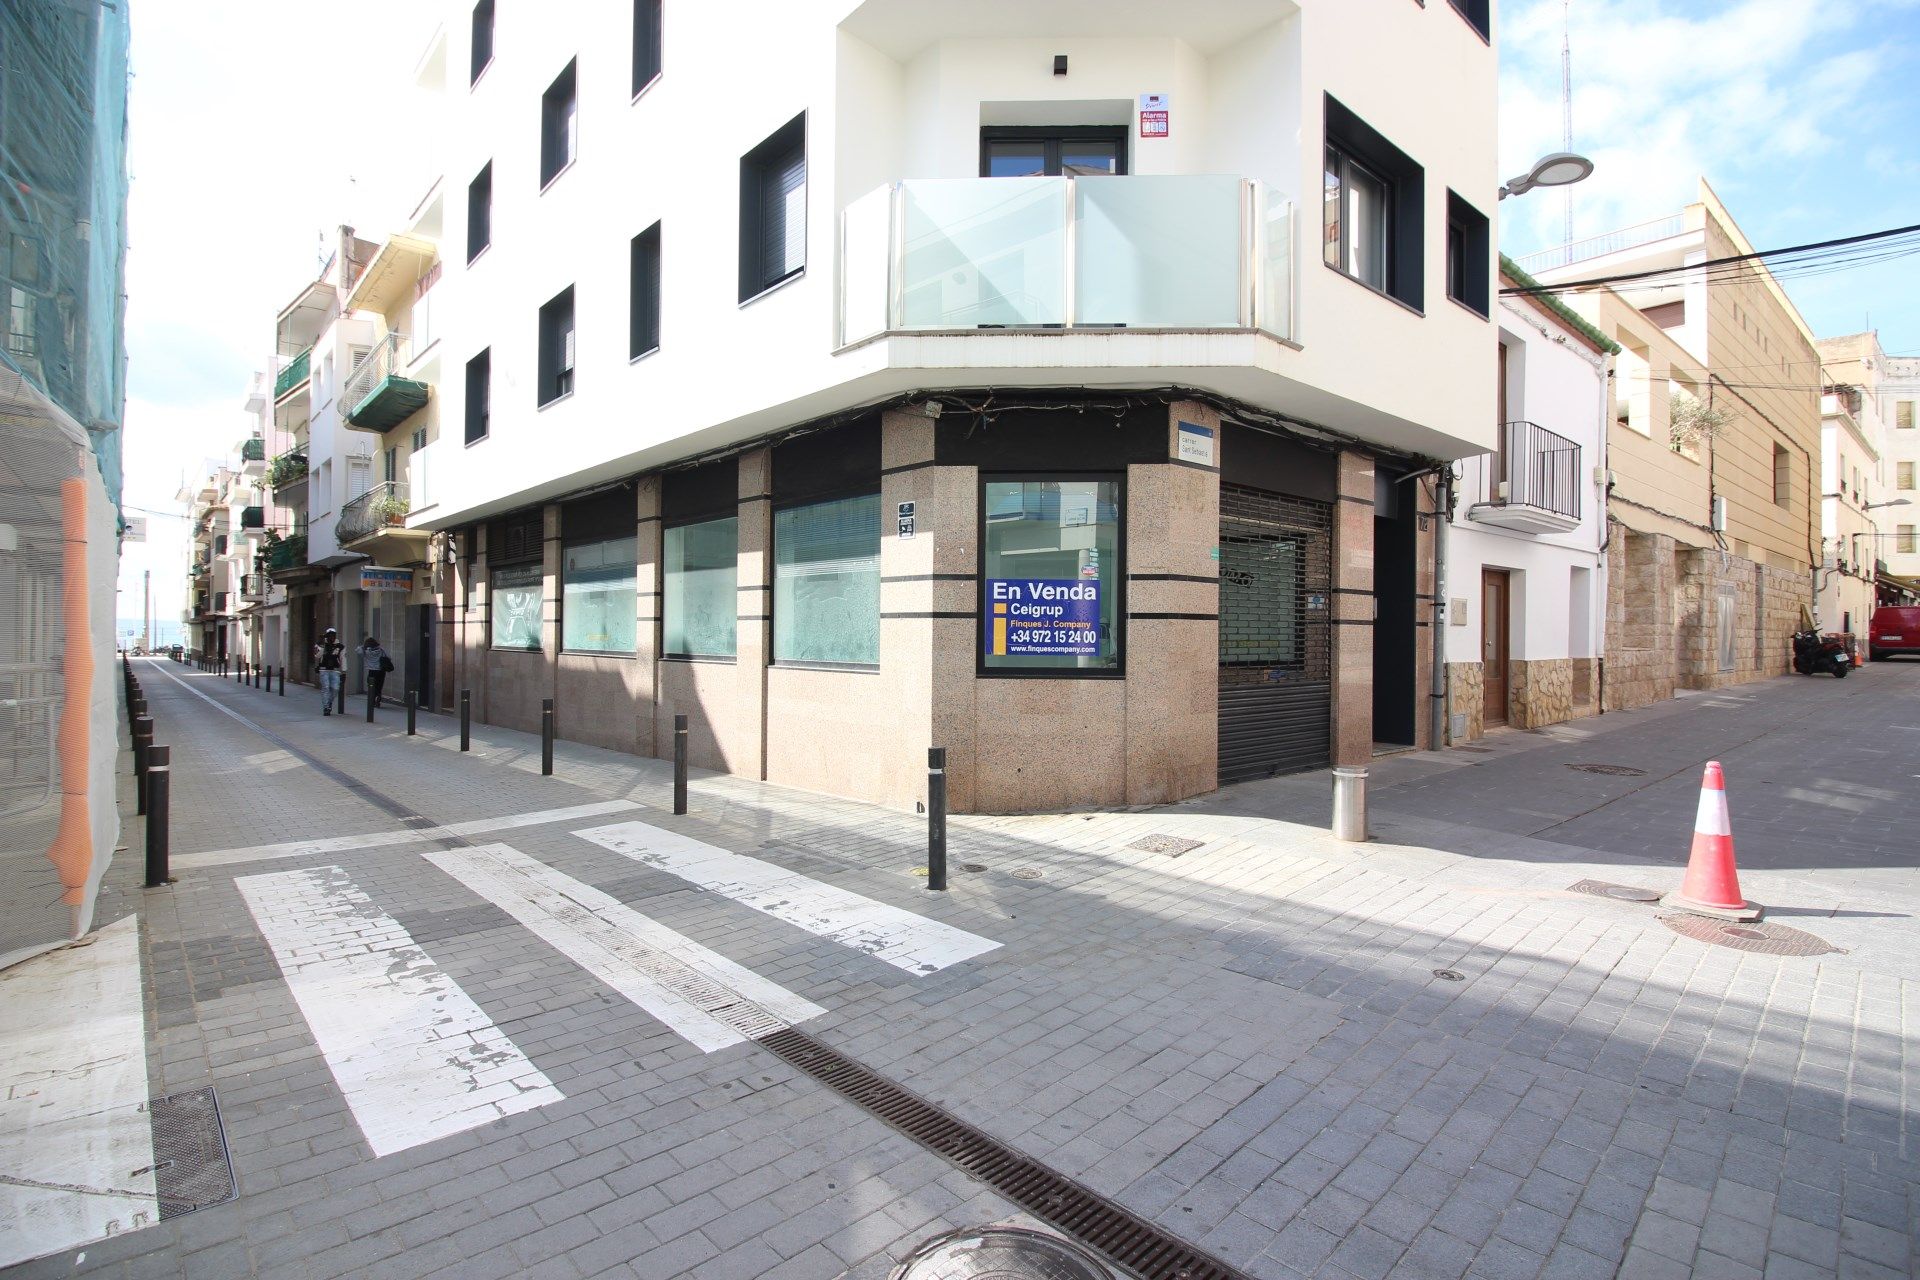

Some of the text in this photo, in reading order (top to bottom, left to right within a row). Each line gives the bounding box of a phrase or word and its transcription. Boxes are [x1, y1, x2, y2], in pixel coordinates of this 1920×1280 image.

[993, 582, 1097, 600] En Venda
[1010, 603, 1063, 618] Ceigrup
[1010, 620, 1042, 628] Finques
[1053, 620, 1091, 629] Company
[1011, 630, 1096, 643] +34 972 15 24 00
[1010, 645, 1096, 653] www.finquescompany.com
